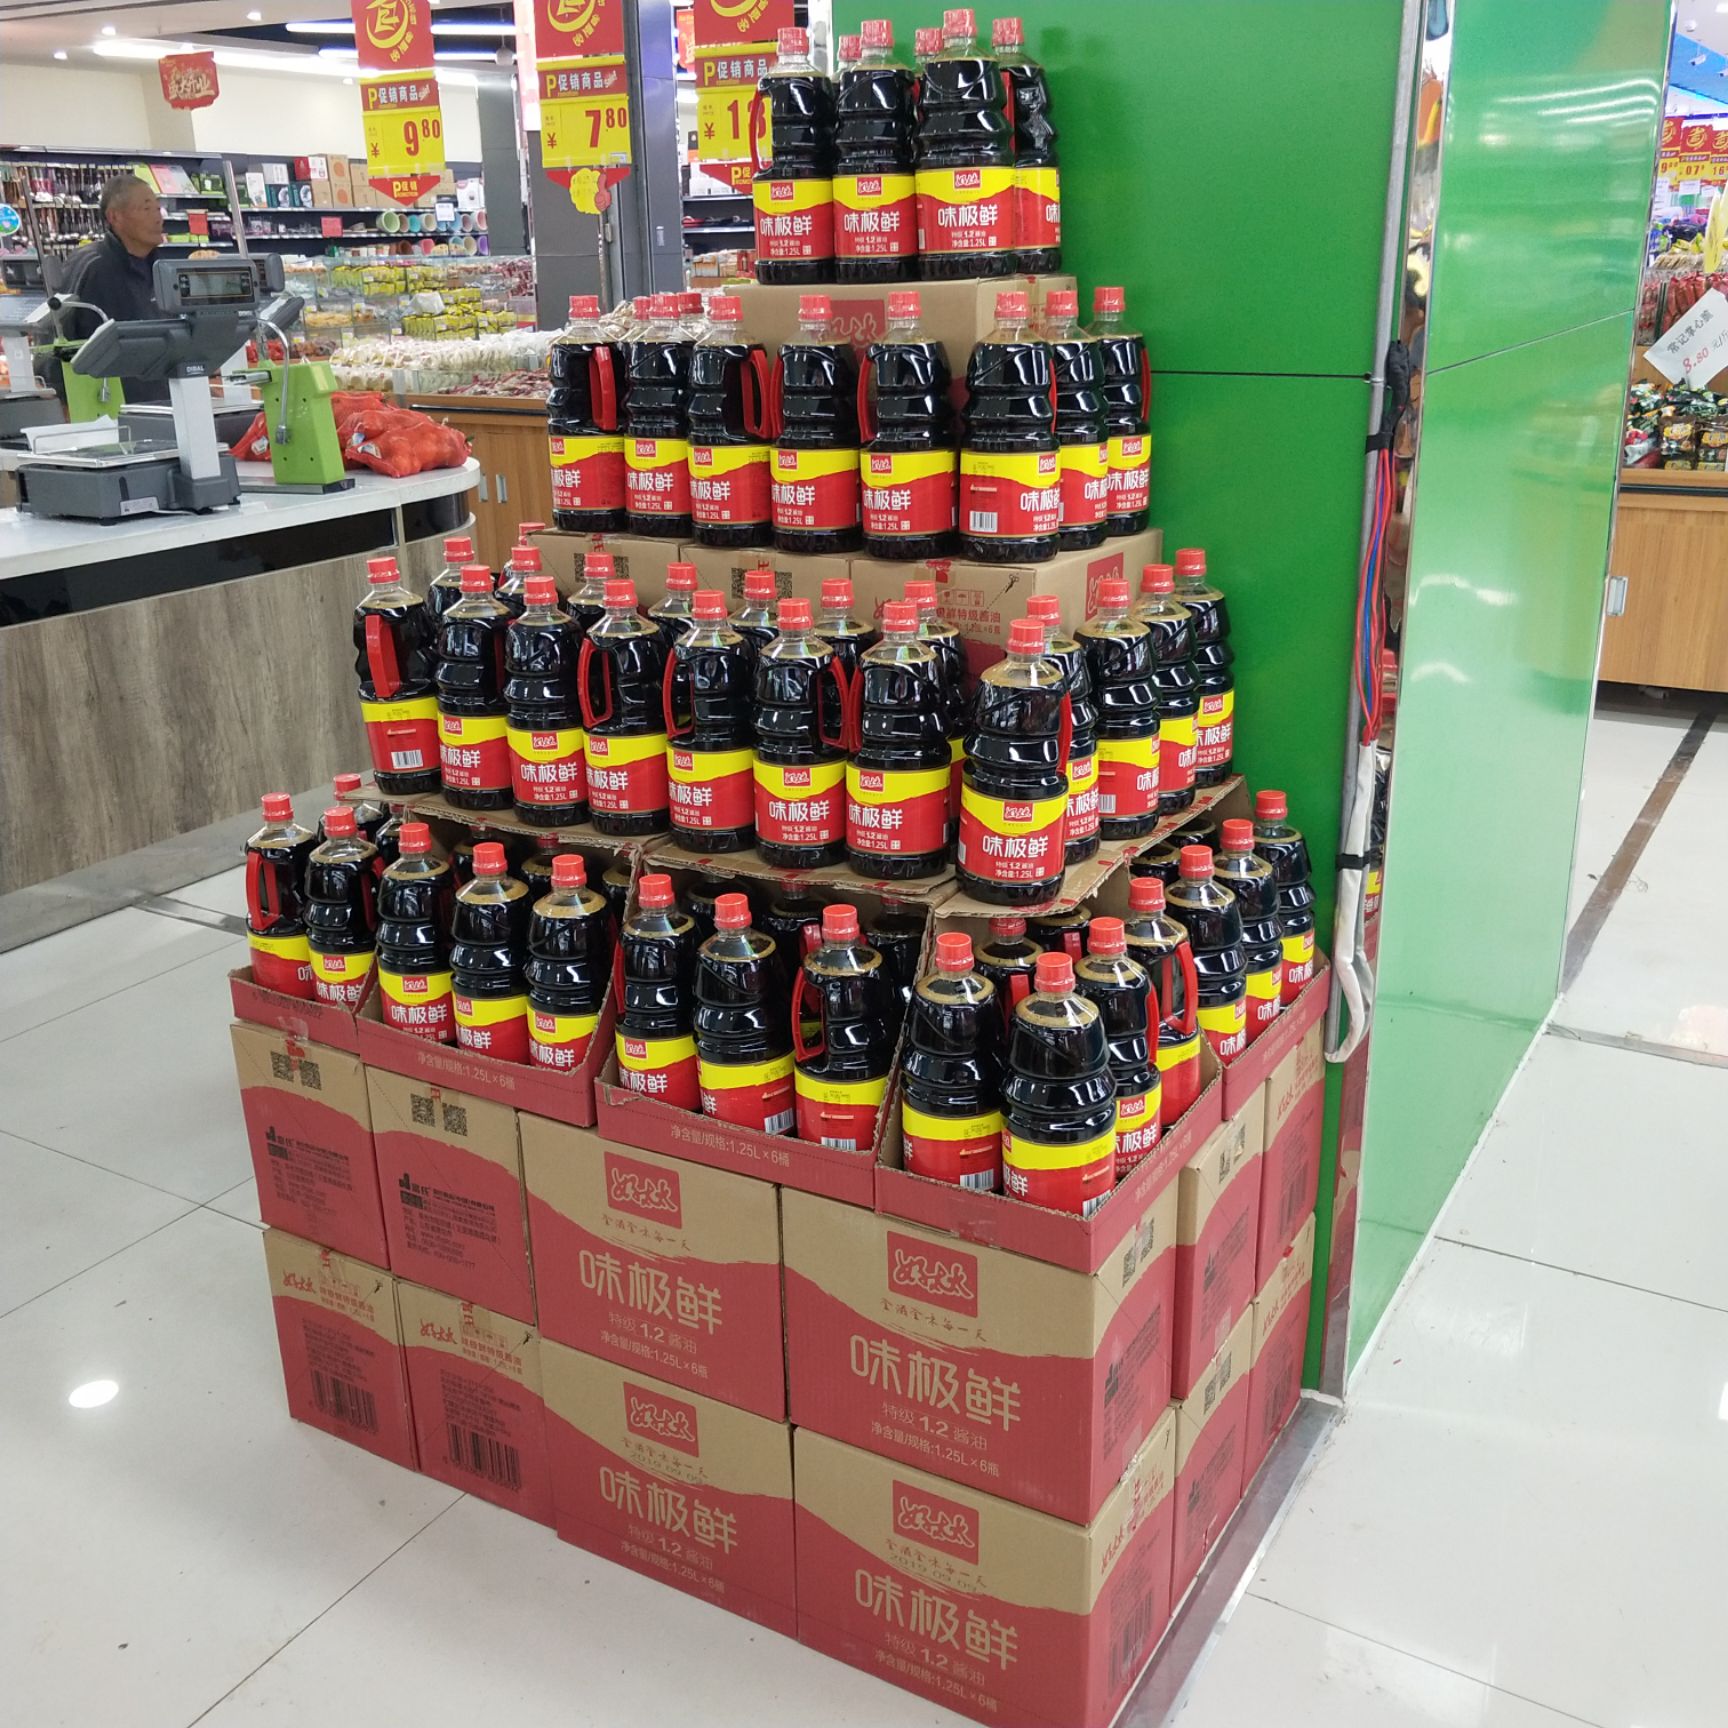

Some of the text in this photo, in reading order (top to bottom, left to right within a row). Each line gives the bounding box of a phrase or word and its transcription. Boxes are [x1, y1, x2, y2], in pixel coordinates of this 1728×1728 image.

[1046, 203, 1060, 223] 味
[982, 835, 1048, 858] 味极鲜
[579, 1250, 722, 1335] 味极鲜
[640, 1323, 664, 1343] 1.2
[850, 1334, 1021, 1431] 味极鲜
[919, 1416, 949, 1438] 1.2
[600, 1466, 738, 1554] 味极鲜
[658, 1537, 681, 1558] 1.2
[855, 1569, 1018, 1670] 味极鲜
[921, 1648, 948, 1670] 1.2
